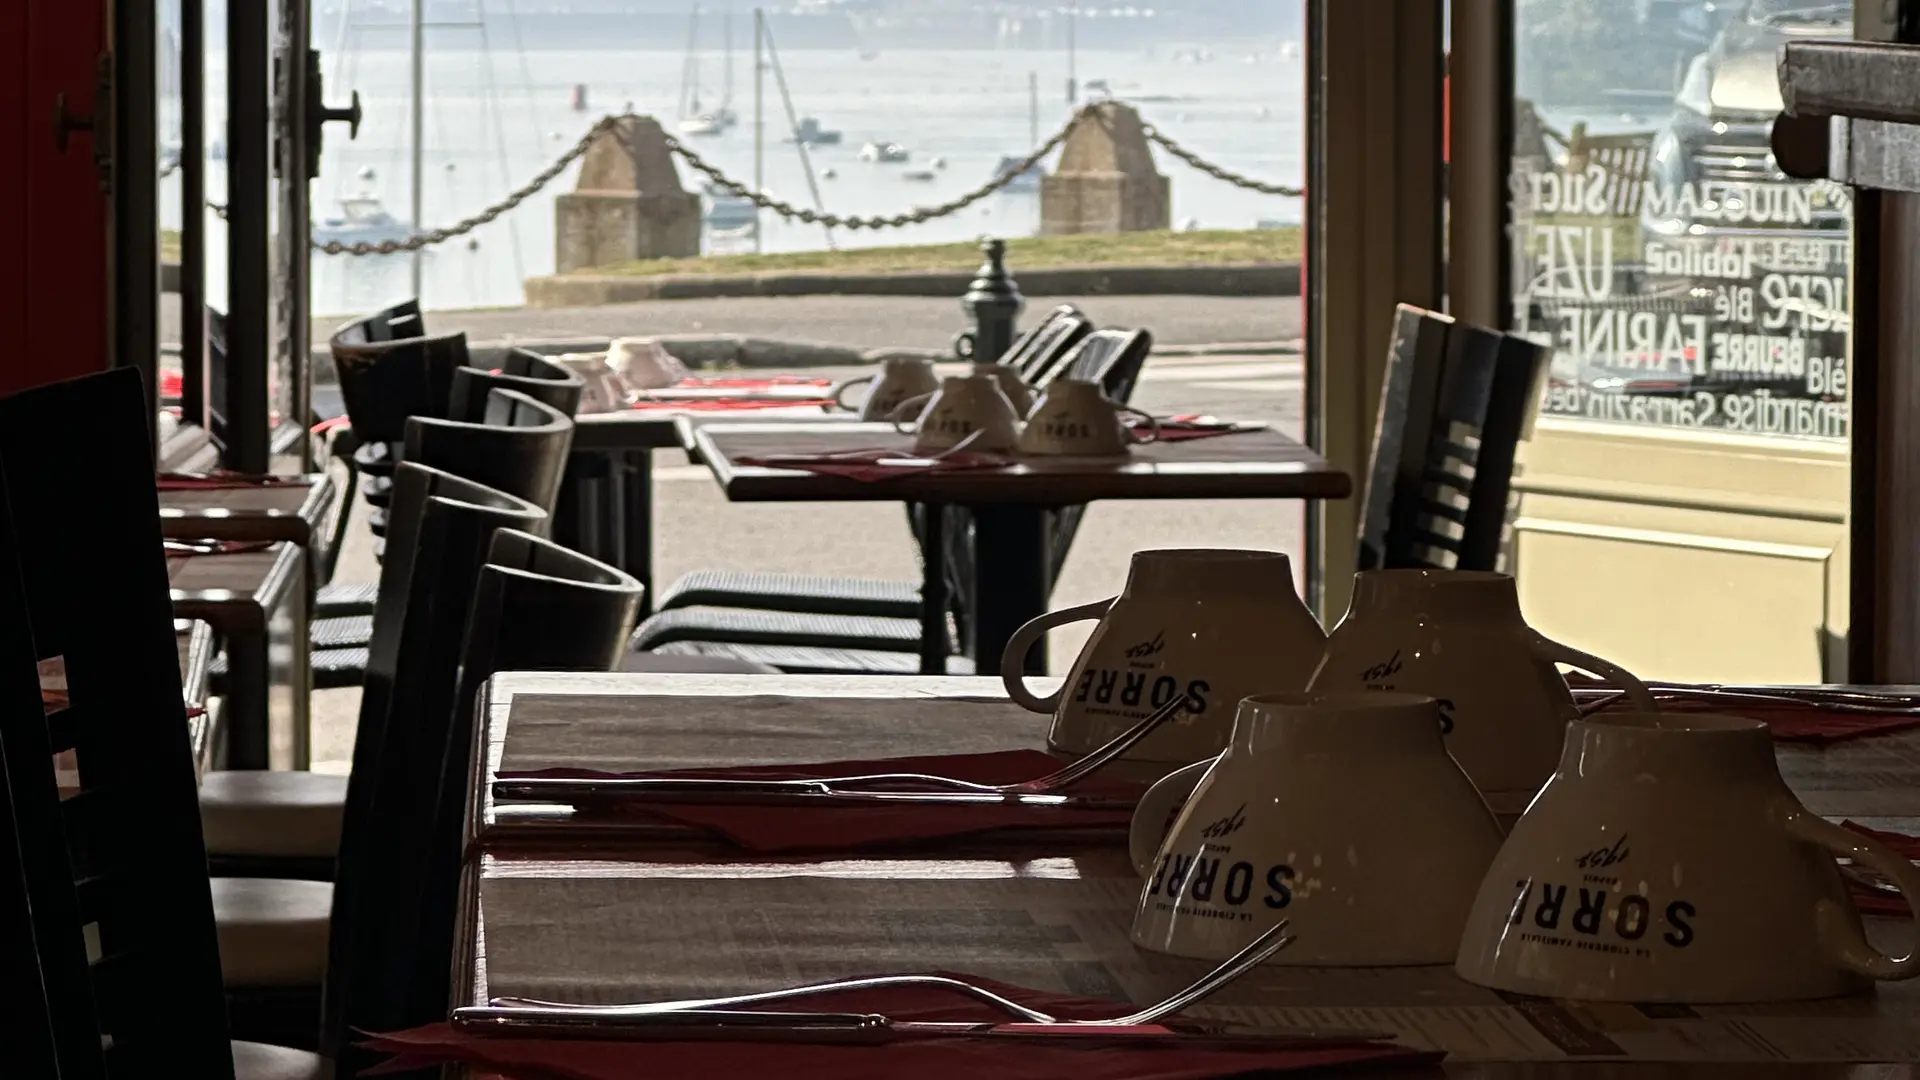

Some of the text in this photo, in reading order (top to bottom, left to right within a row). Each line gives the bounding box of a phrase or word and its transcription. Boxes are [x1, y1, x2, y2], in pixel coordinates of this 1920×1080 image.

[1806, 356, 1847, 396] Blé
[1075, 669, 1210, 715] SORRE
[1150, 853, 1295, 910] SORRE
[1636, 948, 1650, 958] LA
